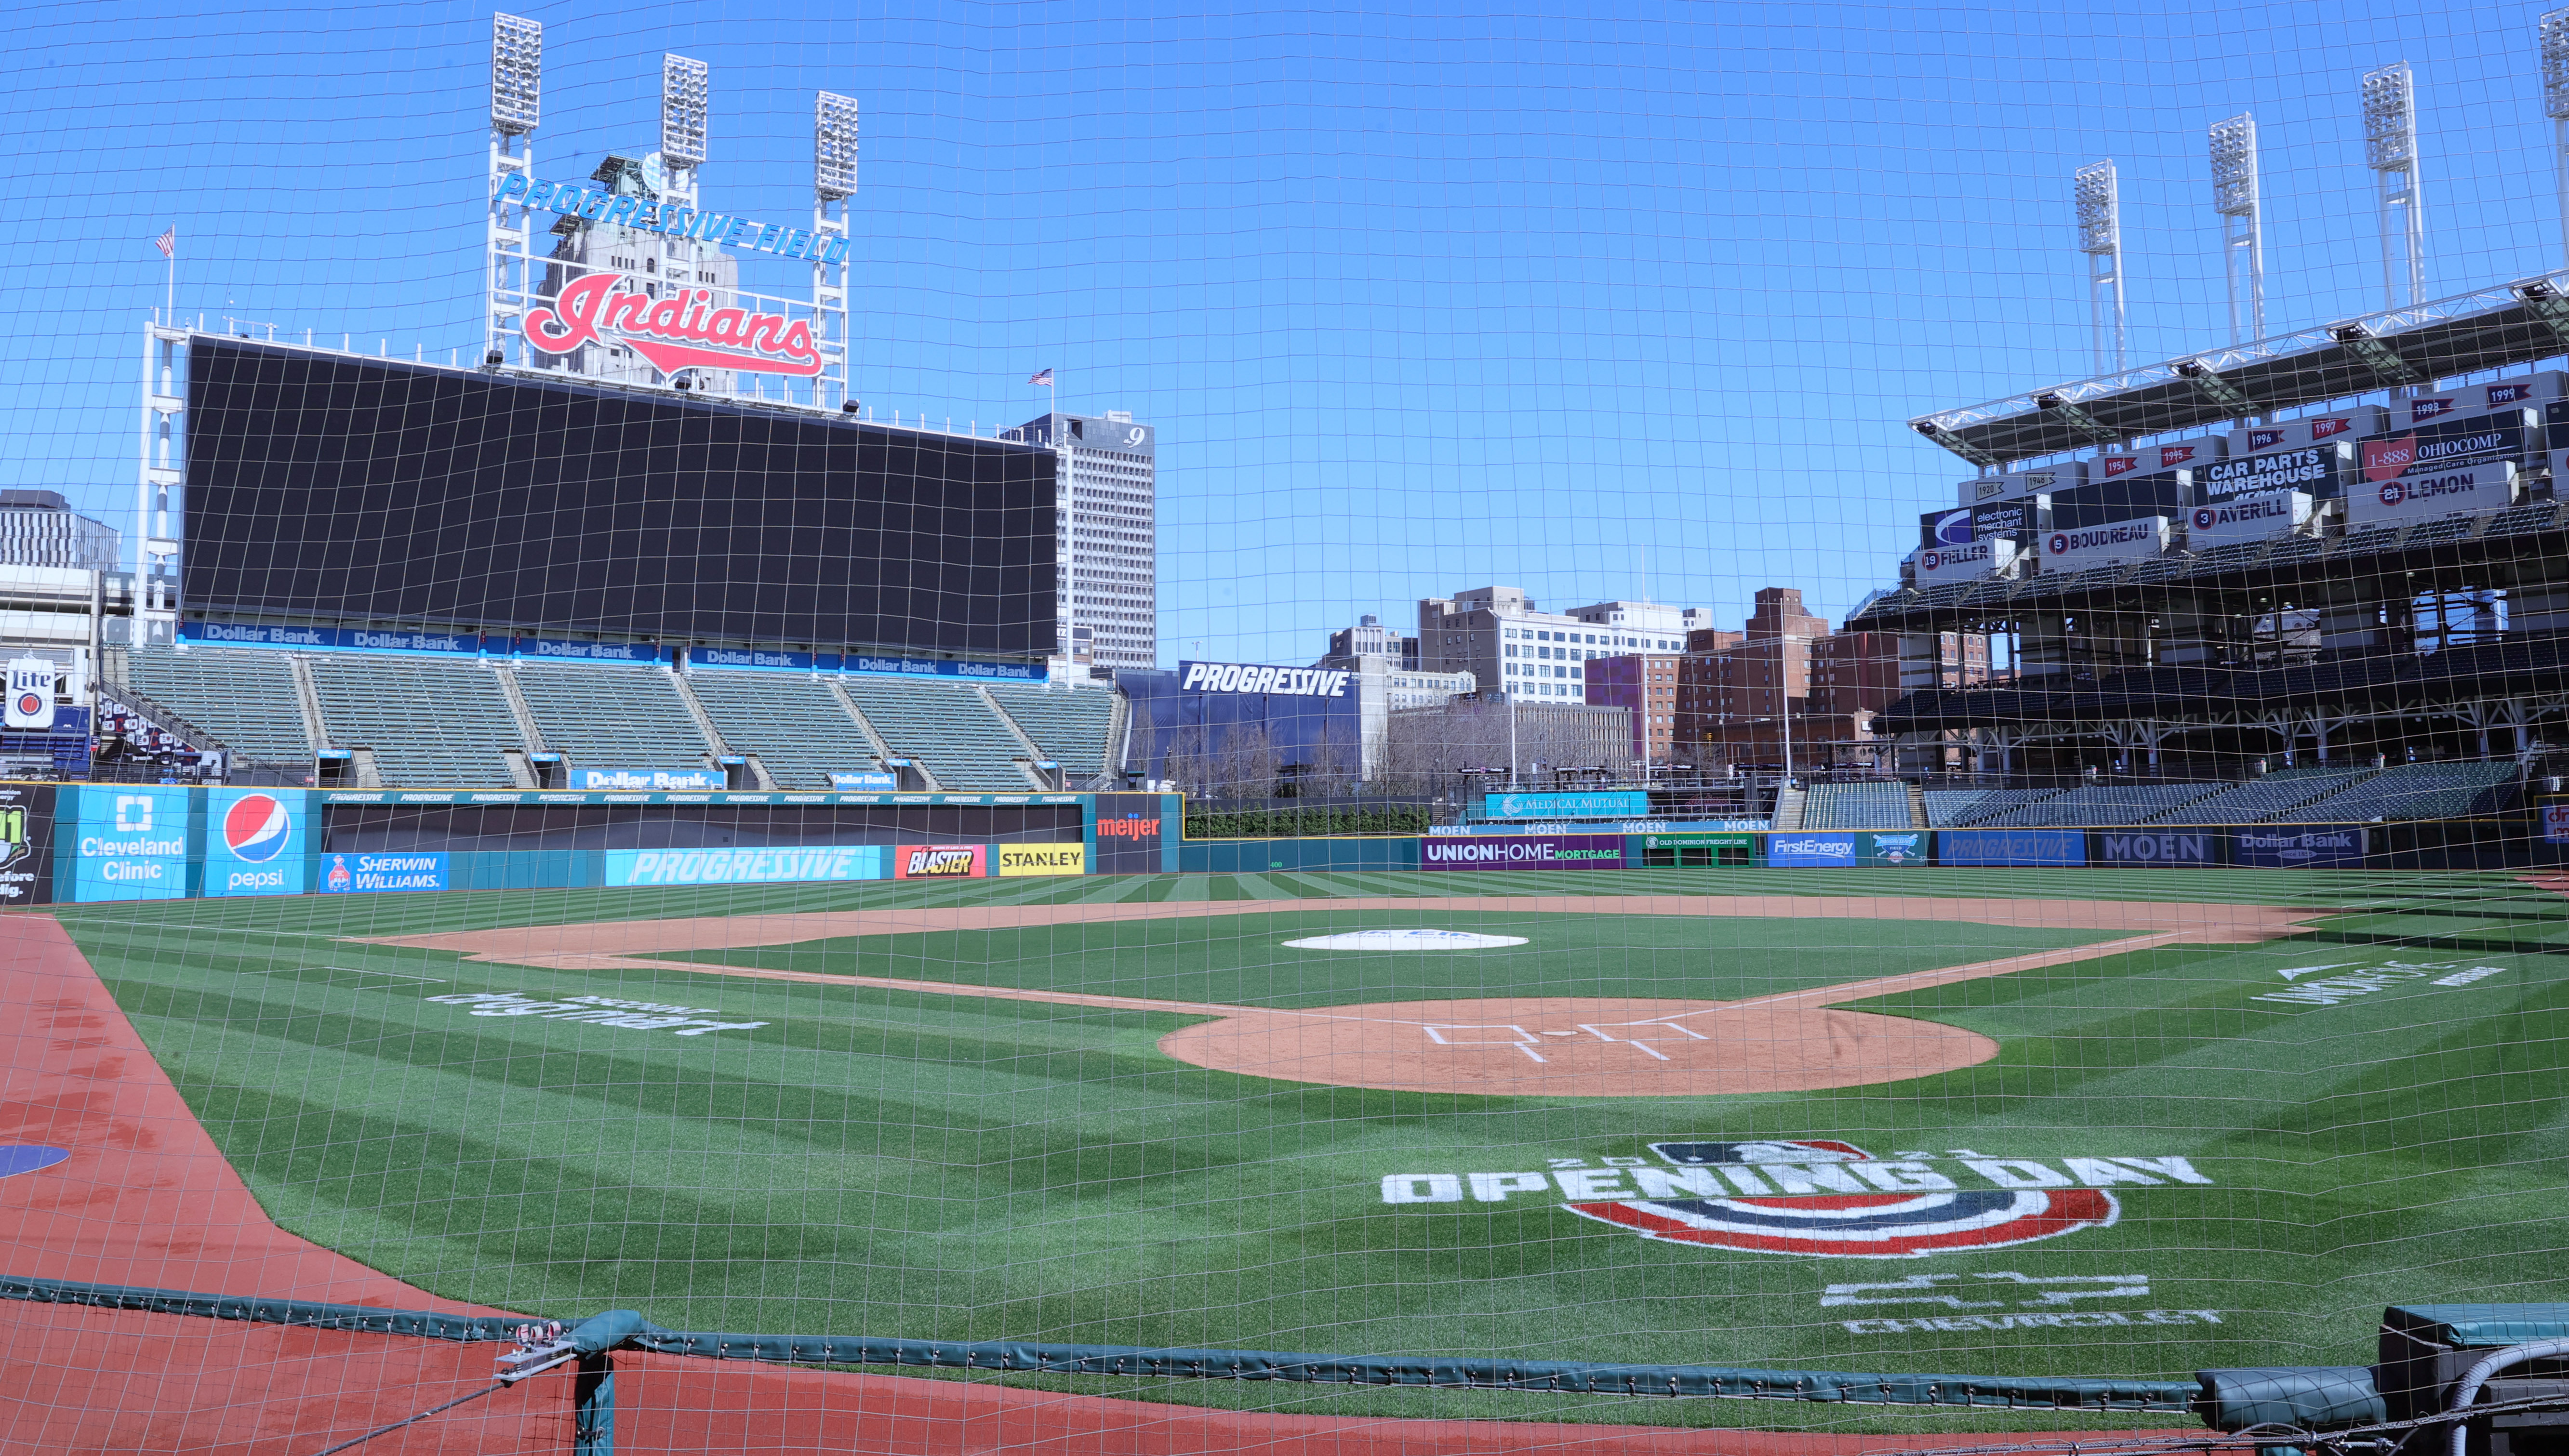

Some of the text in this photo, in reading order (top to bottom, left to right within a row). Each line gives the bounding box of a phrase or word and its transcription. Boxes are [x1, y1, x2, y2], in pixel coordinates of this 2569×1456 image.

[494, 172, 850, 264] PROGRESSIVE FIELD
[524, 273, 823, 378] Indians
[2491, 388, 2515, 401] 1999
[2316, 422, 2336, 434] 1997
[1128, 427, 1145, 449] 9
[2252, 434, 2271, 445] 1996
[2165, 450, 2183, 461] 1995
[2370, 434, 2502, 466] 1-888 OHIOCOMP
[2109, 461, 2125, 471] 1954
[2210, 450, 2318, 480] CAR PARTS
[2408, 451, 2520, 474] Managed Care Organization
[2029, 476, 2045, 485] 1948
[2207, 463, 2326, 496] WAREHOUSE
[2384, 473, 2474, 500] 21 LEMON
[1979, 485, 1994, 494] 1920
[1978, 507, 2022, 522] electronic
[2200, 499, 2287, 524] 3 AVERILL
[1978, 517, 2022, 532] merchant
[1978, 530, 2018, 542] systems
[2055, 524, 2148, 550] 5 BOUDREAU
[1925, 545, 1988, 566] 19 FELLER
[207, 625, 321, 645] Dollar Bank
[354, 632, 458, 650] Dollar Bank
[538, 642, 633, 659] Dollar Bank
[707, 650, 792, 666] Dollar Bank
[859, 658, 936, 674] Dollar Bank
[958, 663, 1030, 677] Dollar Bank
[12, 671, 51, 690] Lite
[1184, 663, 1350, 697] PROGRESSIVE
[586, 772, 707, 788] Dollar Bank
[832, 774, 892, 784] Dollar Bank
[1526, 798, 1629, 808] MEDICAL MUTUAL
[1097, 813, 1159, 841] meijer
[1430, 826, 1470, 835] MOEN
[1525, 824, 1566, 834] MOEN
[1623, 822, 1665, 833] MOEN
[1724, 821, 1768, 831] MOEN
[81, 837, 183, 857] Cleveland
[1774, 840, 1853, 855] FirstEnergy
[1946, 838, 2073, 857] PROGRESSIVE
[2106, 836, 2204, 860] MOEN
[2241, 833, 2352, 847] Dollar Bank
[907, 851, 972, 874] BLASTER
[1002, 852, 1080, 867] STANLEY
[1555, 849, 1620, 859] MORTGAGE
[103, 861, 161, 881] Clinic
[357, 856, 436, 871] SHERWIN
[627, 849, 856, 883] PROGRESSIVE
[230, 870, 282, 890] pepsi
[426, 993, 771, 1035] drug mart
[1548, 1156, 1648, 1168] 20
[1382, 1155, 2213, 1204] OPENING DAY
[1842, 1310, 2223, 1334] CHEVROLET
